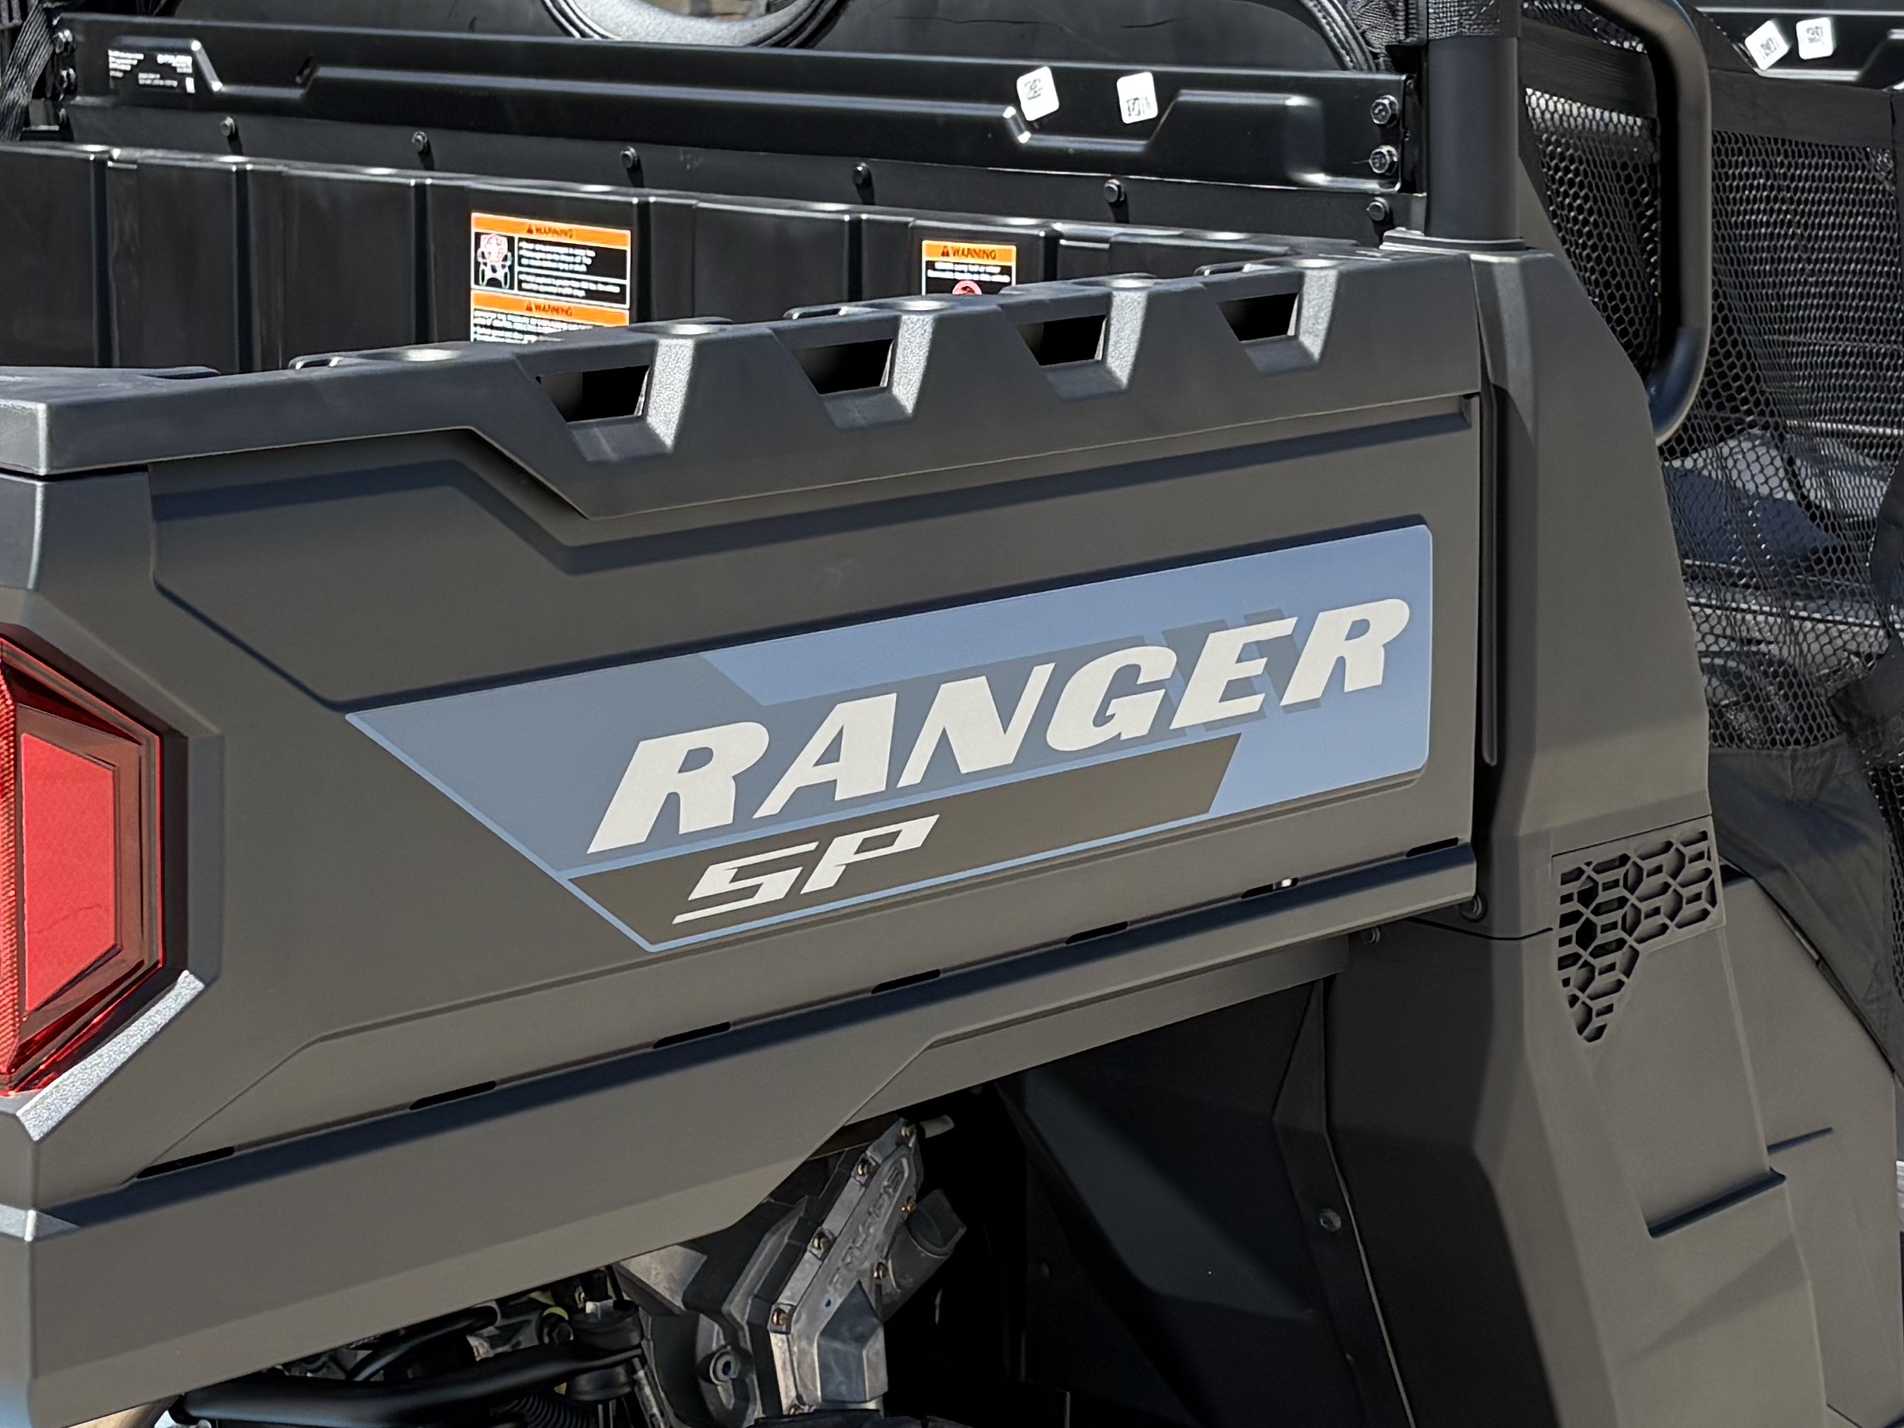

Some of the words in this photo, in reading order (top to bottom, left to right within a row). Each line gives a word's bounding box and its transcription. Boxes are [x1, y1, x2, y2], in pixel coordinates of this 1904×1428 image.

[535, 225, 574, 240] WARNING
[951, 246, 997, 261] WARNING
[534, 302, 573, 317] WARNING
[587, 598, 1411, 854] RANGER
[672, 814, 940, 924] SP
